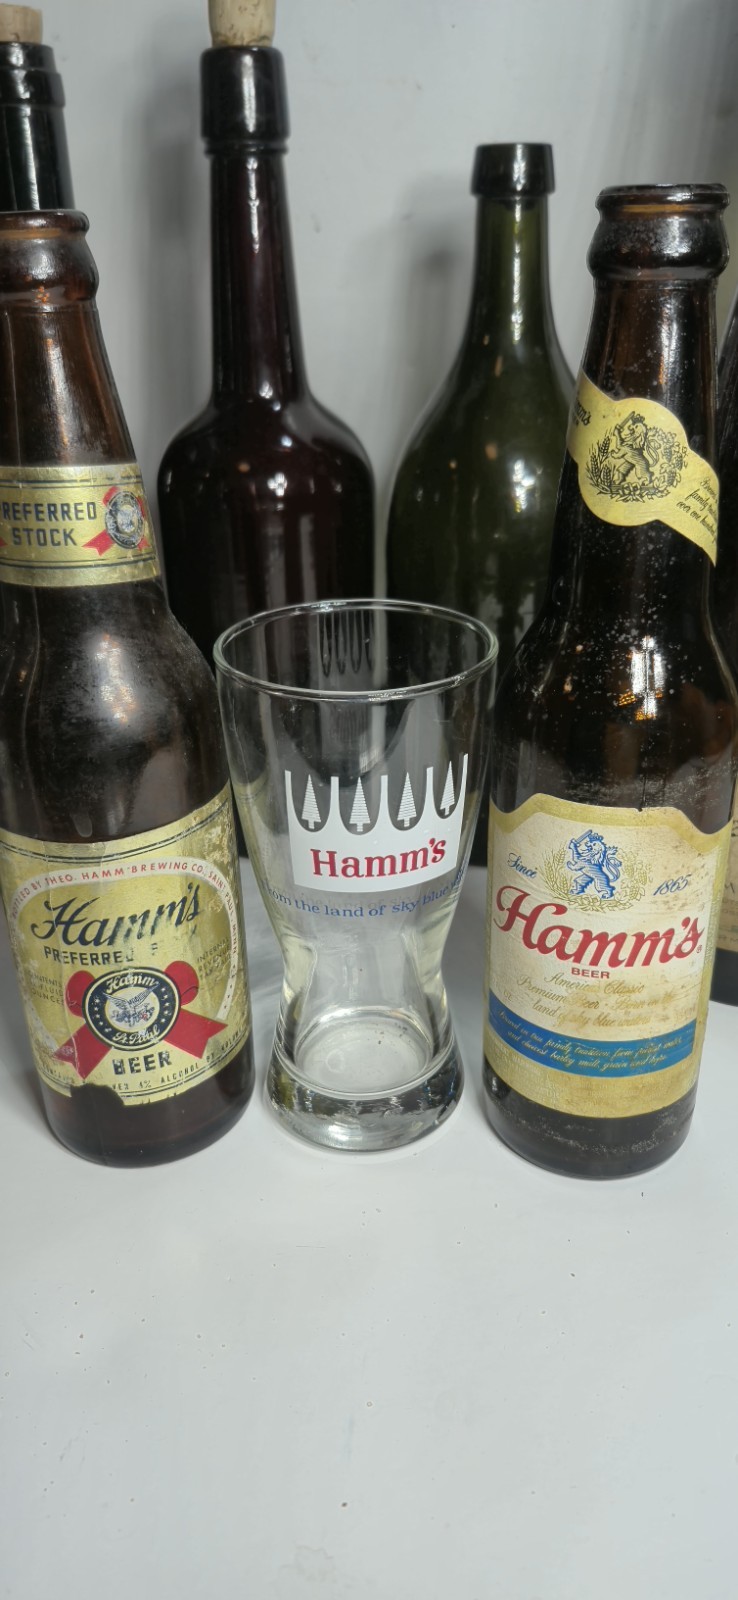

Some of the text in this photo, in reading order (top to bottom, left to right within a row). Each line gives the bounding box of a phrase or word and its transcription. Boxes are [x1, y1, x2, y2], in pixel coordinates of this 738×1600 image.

[0, 502, 97, 522] REFERRED
[12, 527, 77, 547] STOCK
[310, 837, 447, 878] Hamm's
[31, 879, 42, 891] BY
[82, 868, 124, 880] HAMM
[131, 861, 188, 874] BREWING
[653, 874, 692, 896] 1865
[31, 882, 202, 946] Hamm's
[294, 899, 321, 914] the
[324, 905, 364, 917] land
[368, 905, 385, 917] of
[391, 898, 419, 913] sky
[422, 886, 449, 905] blue
[493, 885, 704, 968] Hamm's
[571, 967, 610, 979] BEER
[517, 975, 567, 1004] Premium
[532, 1000, 560, 1018] land
[111, 1083, 130, 1091] VER
[160, 1062, 199, 1083] ALCOHOL
[112, 1049, 172, 1075] BEER
